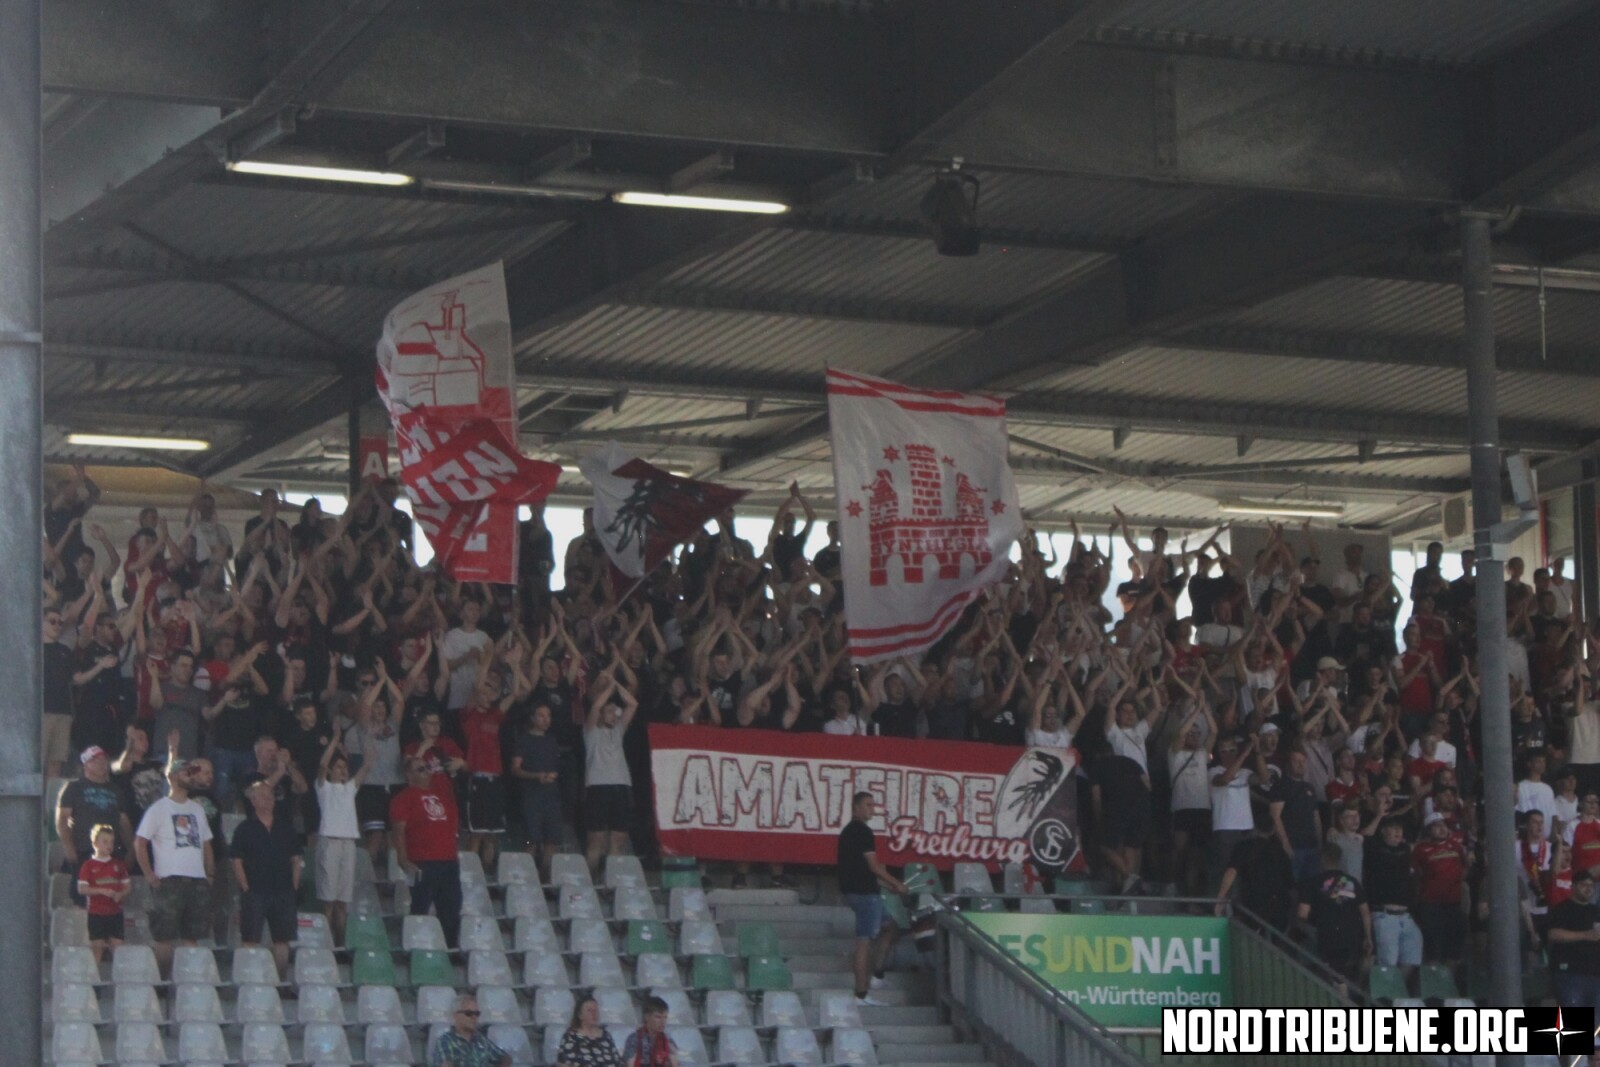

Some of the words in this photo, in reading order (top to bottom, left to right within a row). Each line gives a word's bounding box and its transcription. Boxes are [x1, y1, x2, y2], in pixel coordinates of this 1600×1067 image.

[673, 755, 998, 836] AMATEURE
[889, 817, 1030, 865] Freiburg
[997, 934, 1221, 975] ESUNDNAH
[1058, 984, 1221, 1007] n-Württemberg
